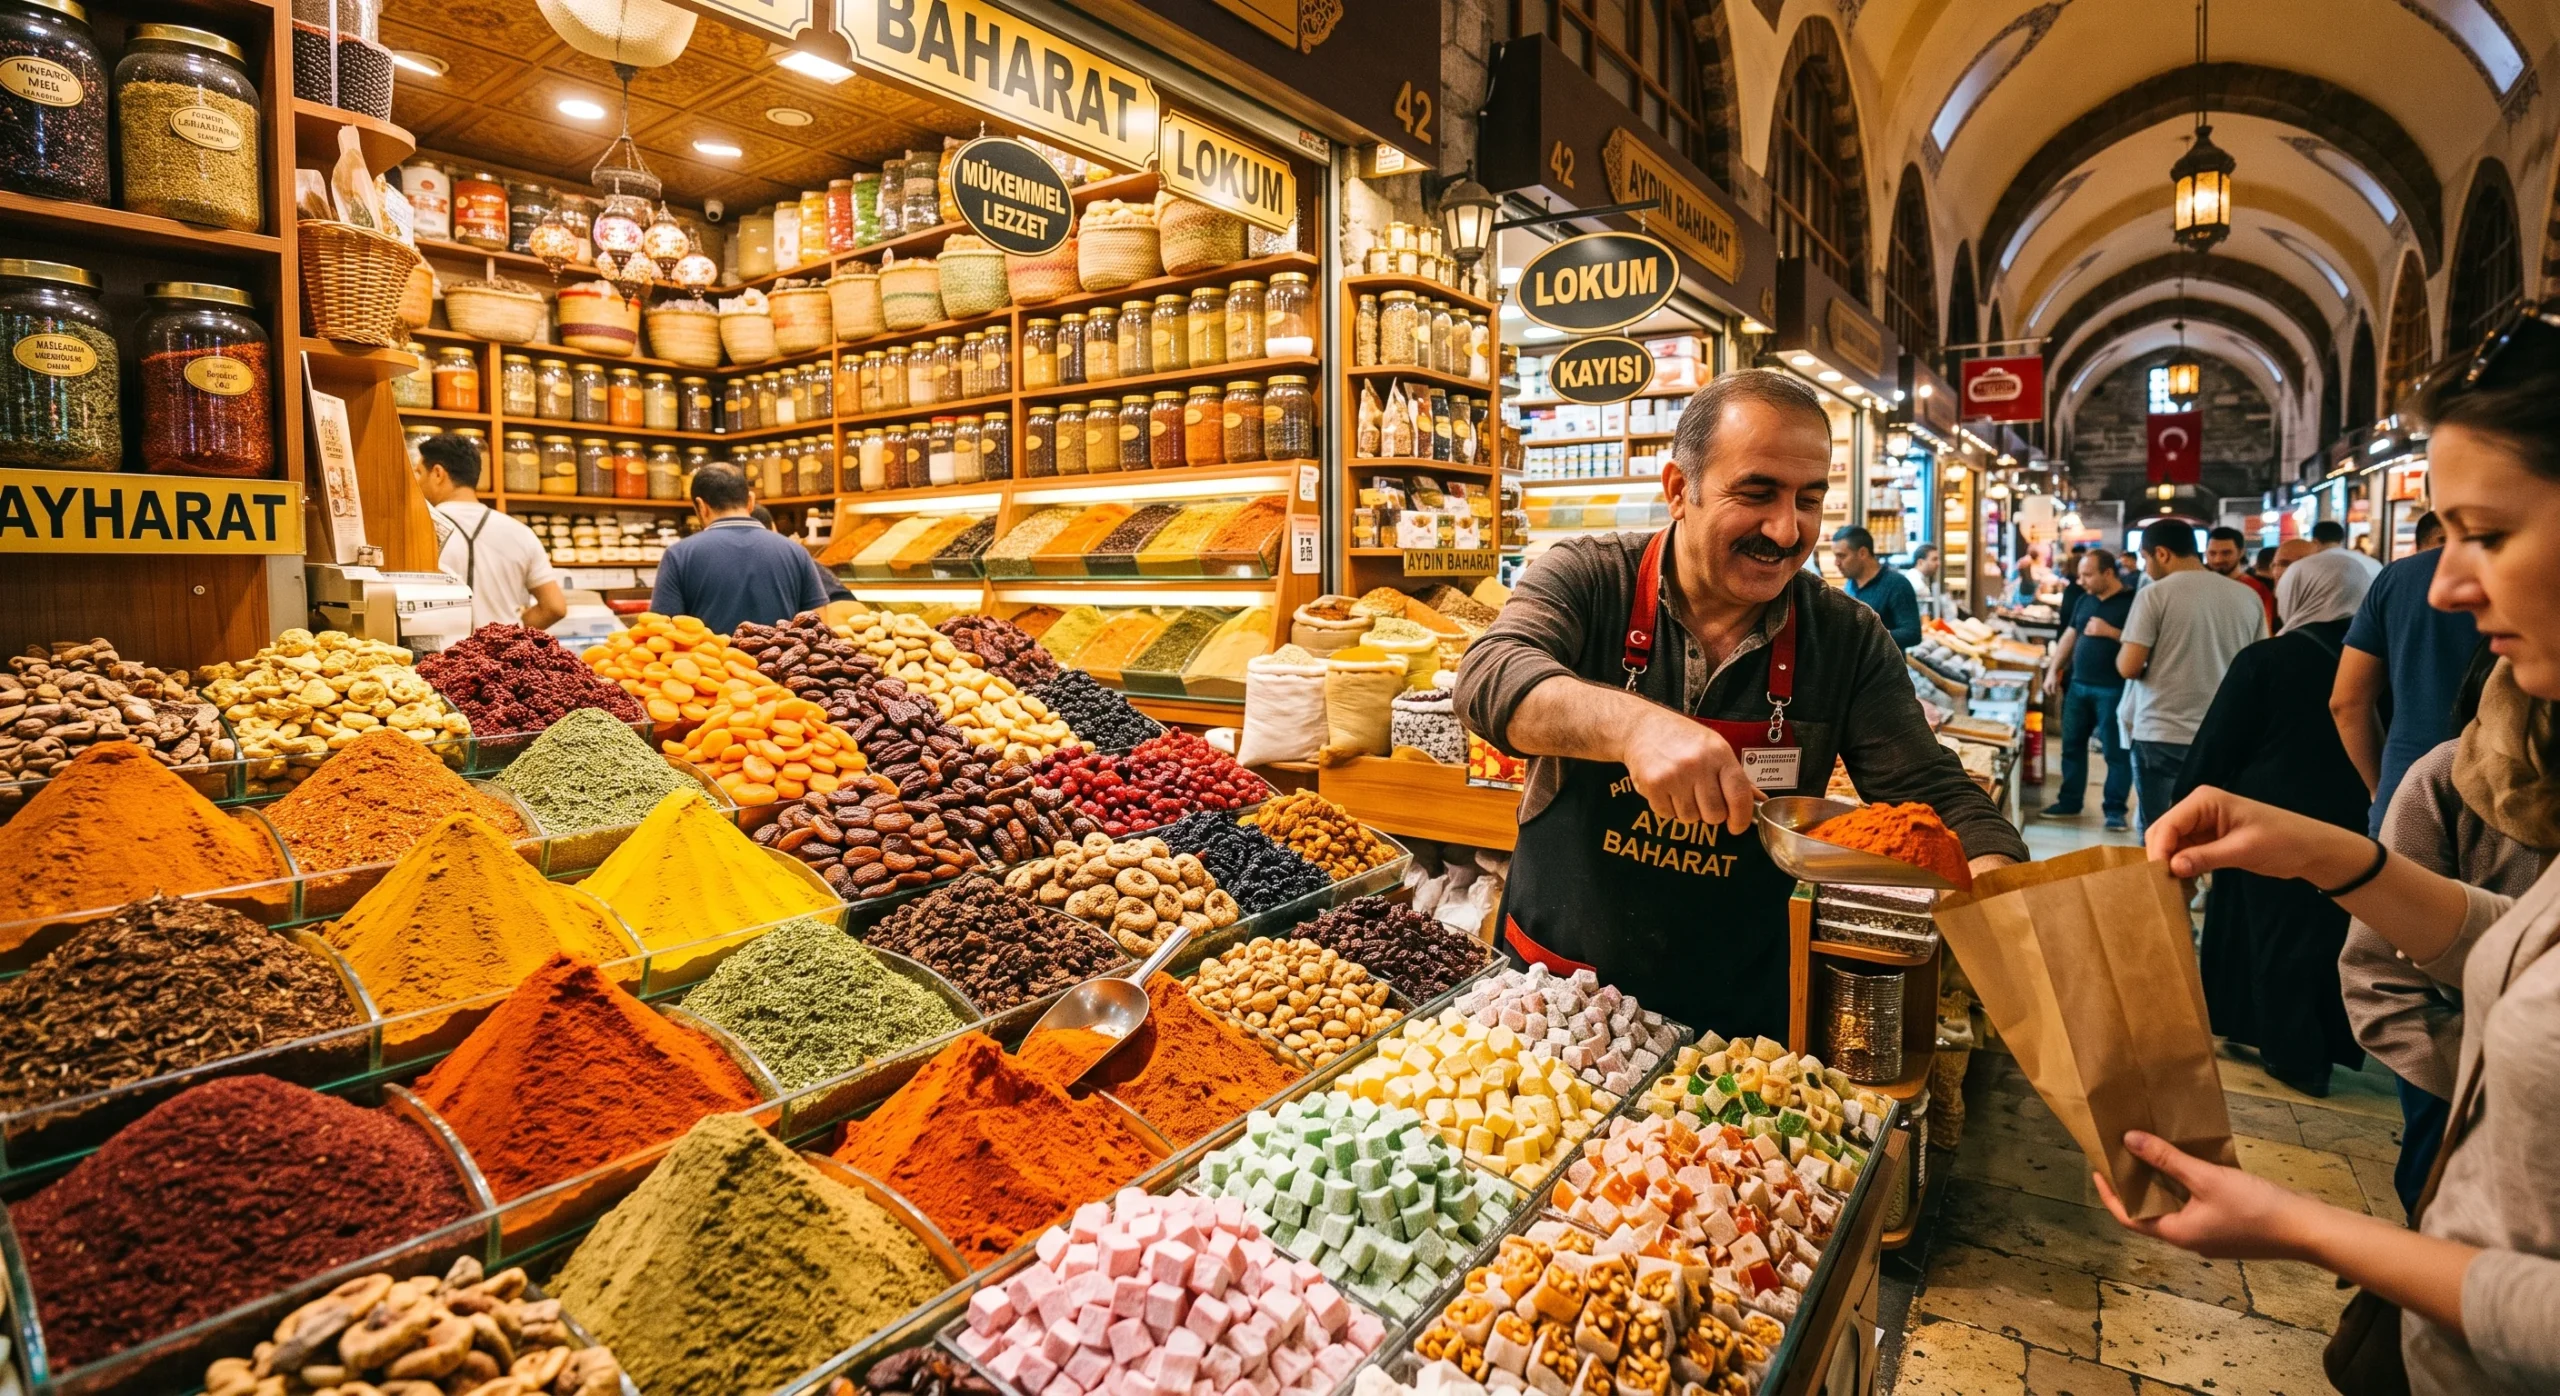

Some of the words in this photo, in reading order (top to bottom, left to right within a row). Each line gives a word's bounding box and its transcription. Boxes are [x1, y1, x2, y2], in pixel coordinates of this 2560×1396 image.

[876, 0, 1137, 143] BAHARAT
[1395, 80, 1432, 145] 42
[962, 158, 1066, 215] MÜKEMMEL
[1177, 128, 1283, 216] LOKUM
[1550, 140, 1575, 190] 42
[983, 199, 1048, 241] LEZZET
[1629, 159, 1673, 221] AYDIN
[1676, 194, 1731, 262] BAHARAT
[1535, 256, 1658, 307] LOKUM
[1559, 354, 1642, 388] KAYISI
[0, 485, 286, 541] AYHARAT
[1408, 553, 1443, 571] AYDIN
[1447, 553, 1496, 571] BAHARAT
[1603, 829, 1738, 878] BAHARAT
[1631, 810, 1719, 847] AYDIN
